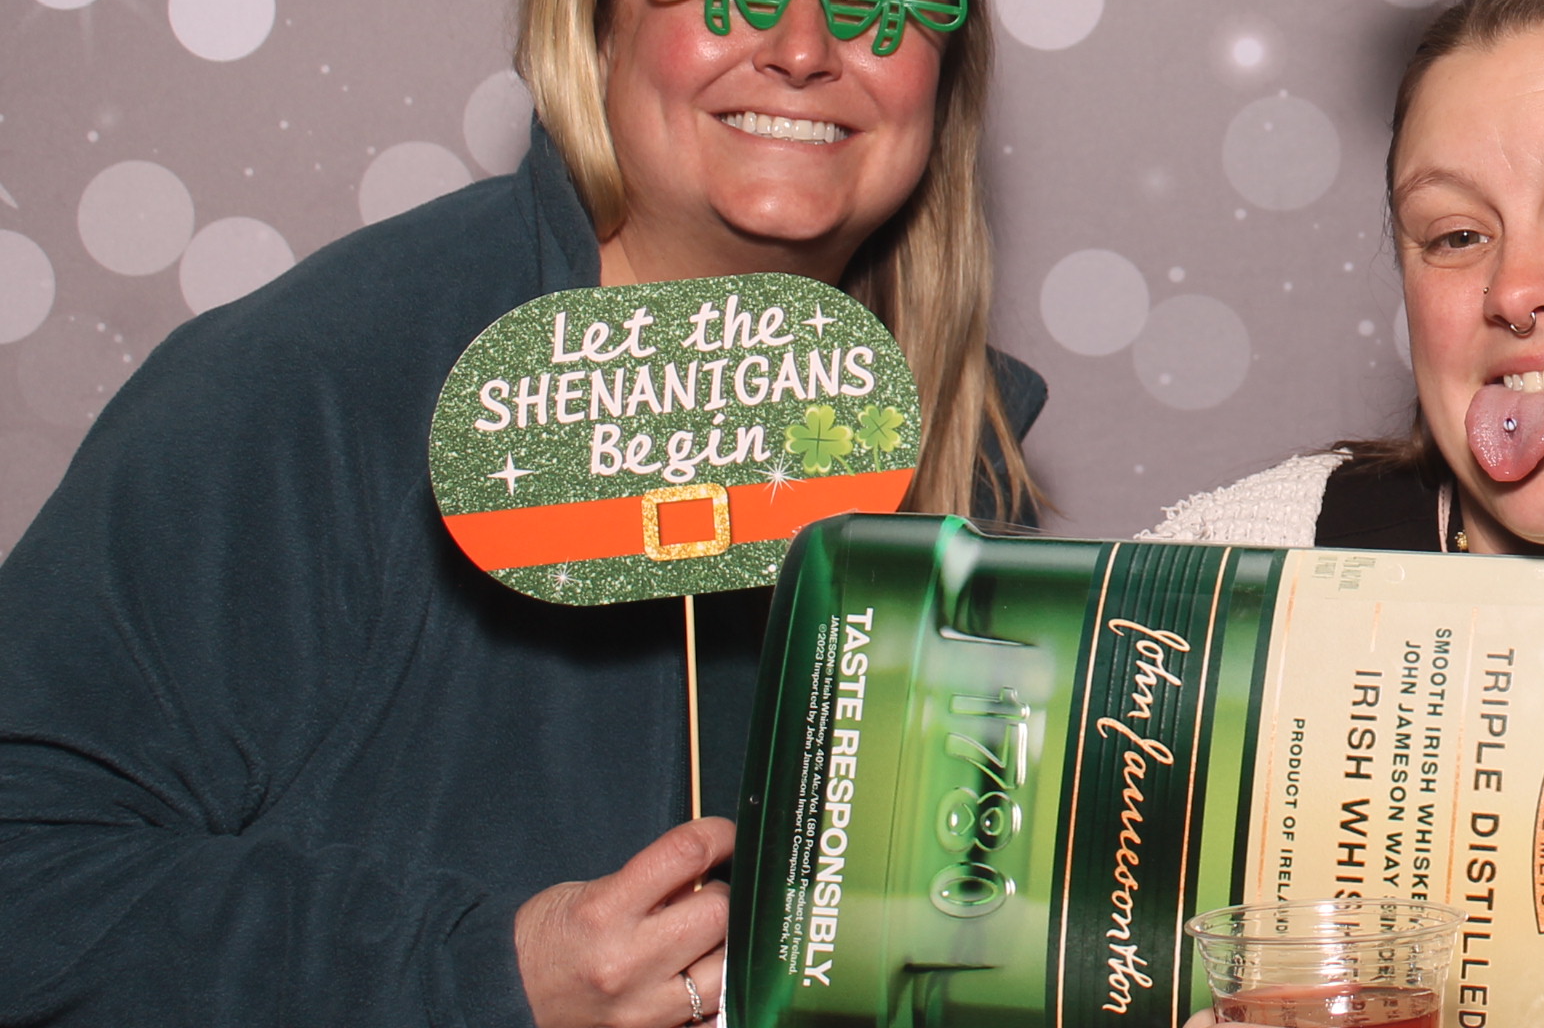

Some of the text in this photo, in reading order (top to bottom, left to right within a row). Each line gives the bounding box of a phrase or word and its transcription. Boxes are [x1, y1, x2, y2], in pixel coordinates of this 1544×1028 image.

[551, 294, 795, 365] Let the
[473, 346, 876, 433] SHENANIGANS
[591, 413, 772, 485] Begin
[809, 662, 822, 709] Imported
[822, 678, 833, 699] Irish
[1108, 618, 1191, 719] John
[1400, 641, 1421, 694] JOHN
[1427, 628, 1452, 716] SMOOTH
[804, 726, 815, 750] John
[806, 711, 817, 724] by
[1344, 670, 1383, 780] IRISH
[798, 752, 812, 796] Jameson
[814, 748, 825, 770] 40%
[1285, 718, 1306, 808] PRODUCT
[1388, 703, 1414, 821] JAMESON
[1420, 727, 1441, 792] IRISH
[794, 798, 806, 832] Import
[802, 608, 874, 986] TASTE RESPONSIBLY.
[929, 686, 1031, 919] 1780
[806, 818, 817, 836] (80
[1282, 816, 1296, 841] OF
[1459, 648, 1515, 1028] TRIPLE DISTILLED
[786, 836, 802, 886] Company,
[1383, 832, 1403, 888] WAY
[785, 888, 796, 912] New
[795, 878, 809, 921] Product
[779, 914, 793, 942] York,
[794, 924, 803, 936] of
[778, 944, 789, 961] NY
[788, 937, 802, 975] Ireland.
